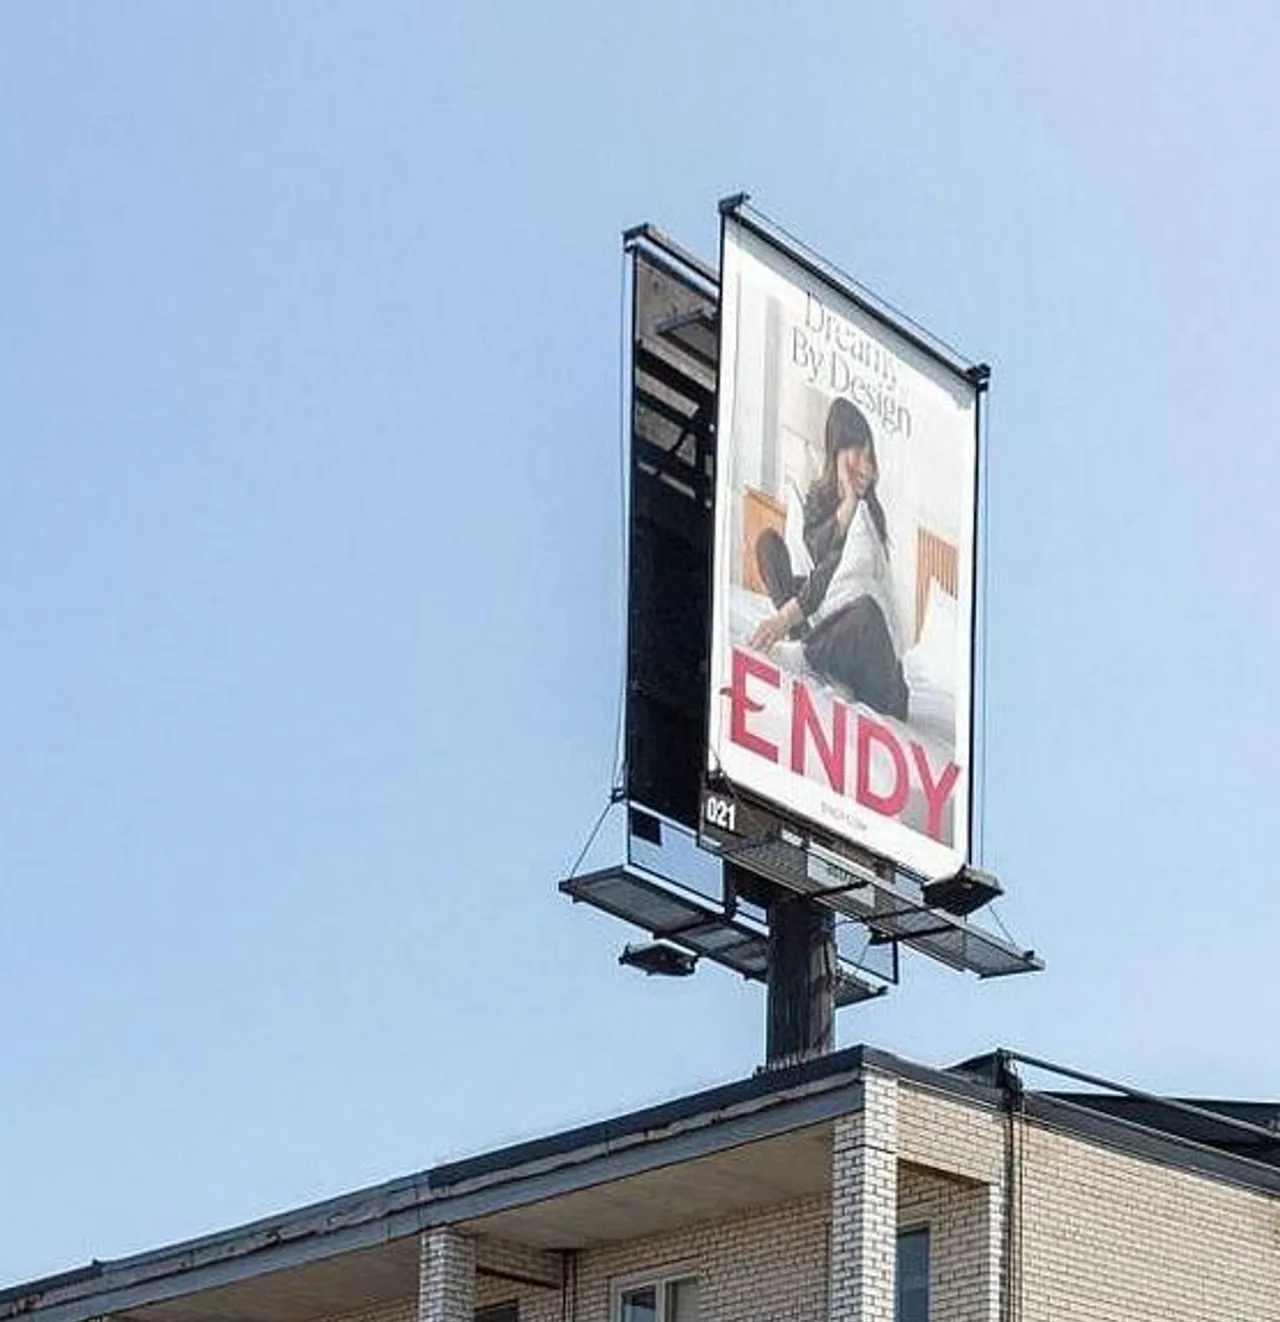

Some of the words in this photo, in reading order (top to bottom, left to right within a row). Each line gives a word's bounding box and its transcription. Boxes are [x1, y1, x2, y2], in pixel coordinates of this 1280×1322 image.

[792, 326, 824, 383] By
[830, 351, 912, 440] Design
[720, 647, 960, 841] ENDY
[707, 798, 736, 830] 021
